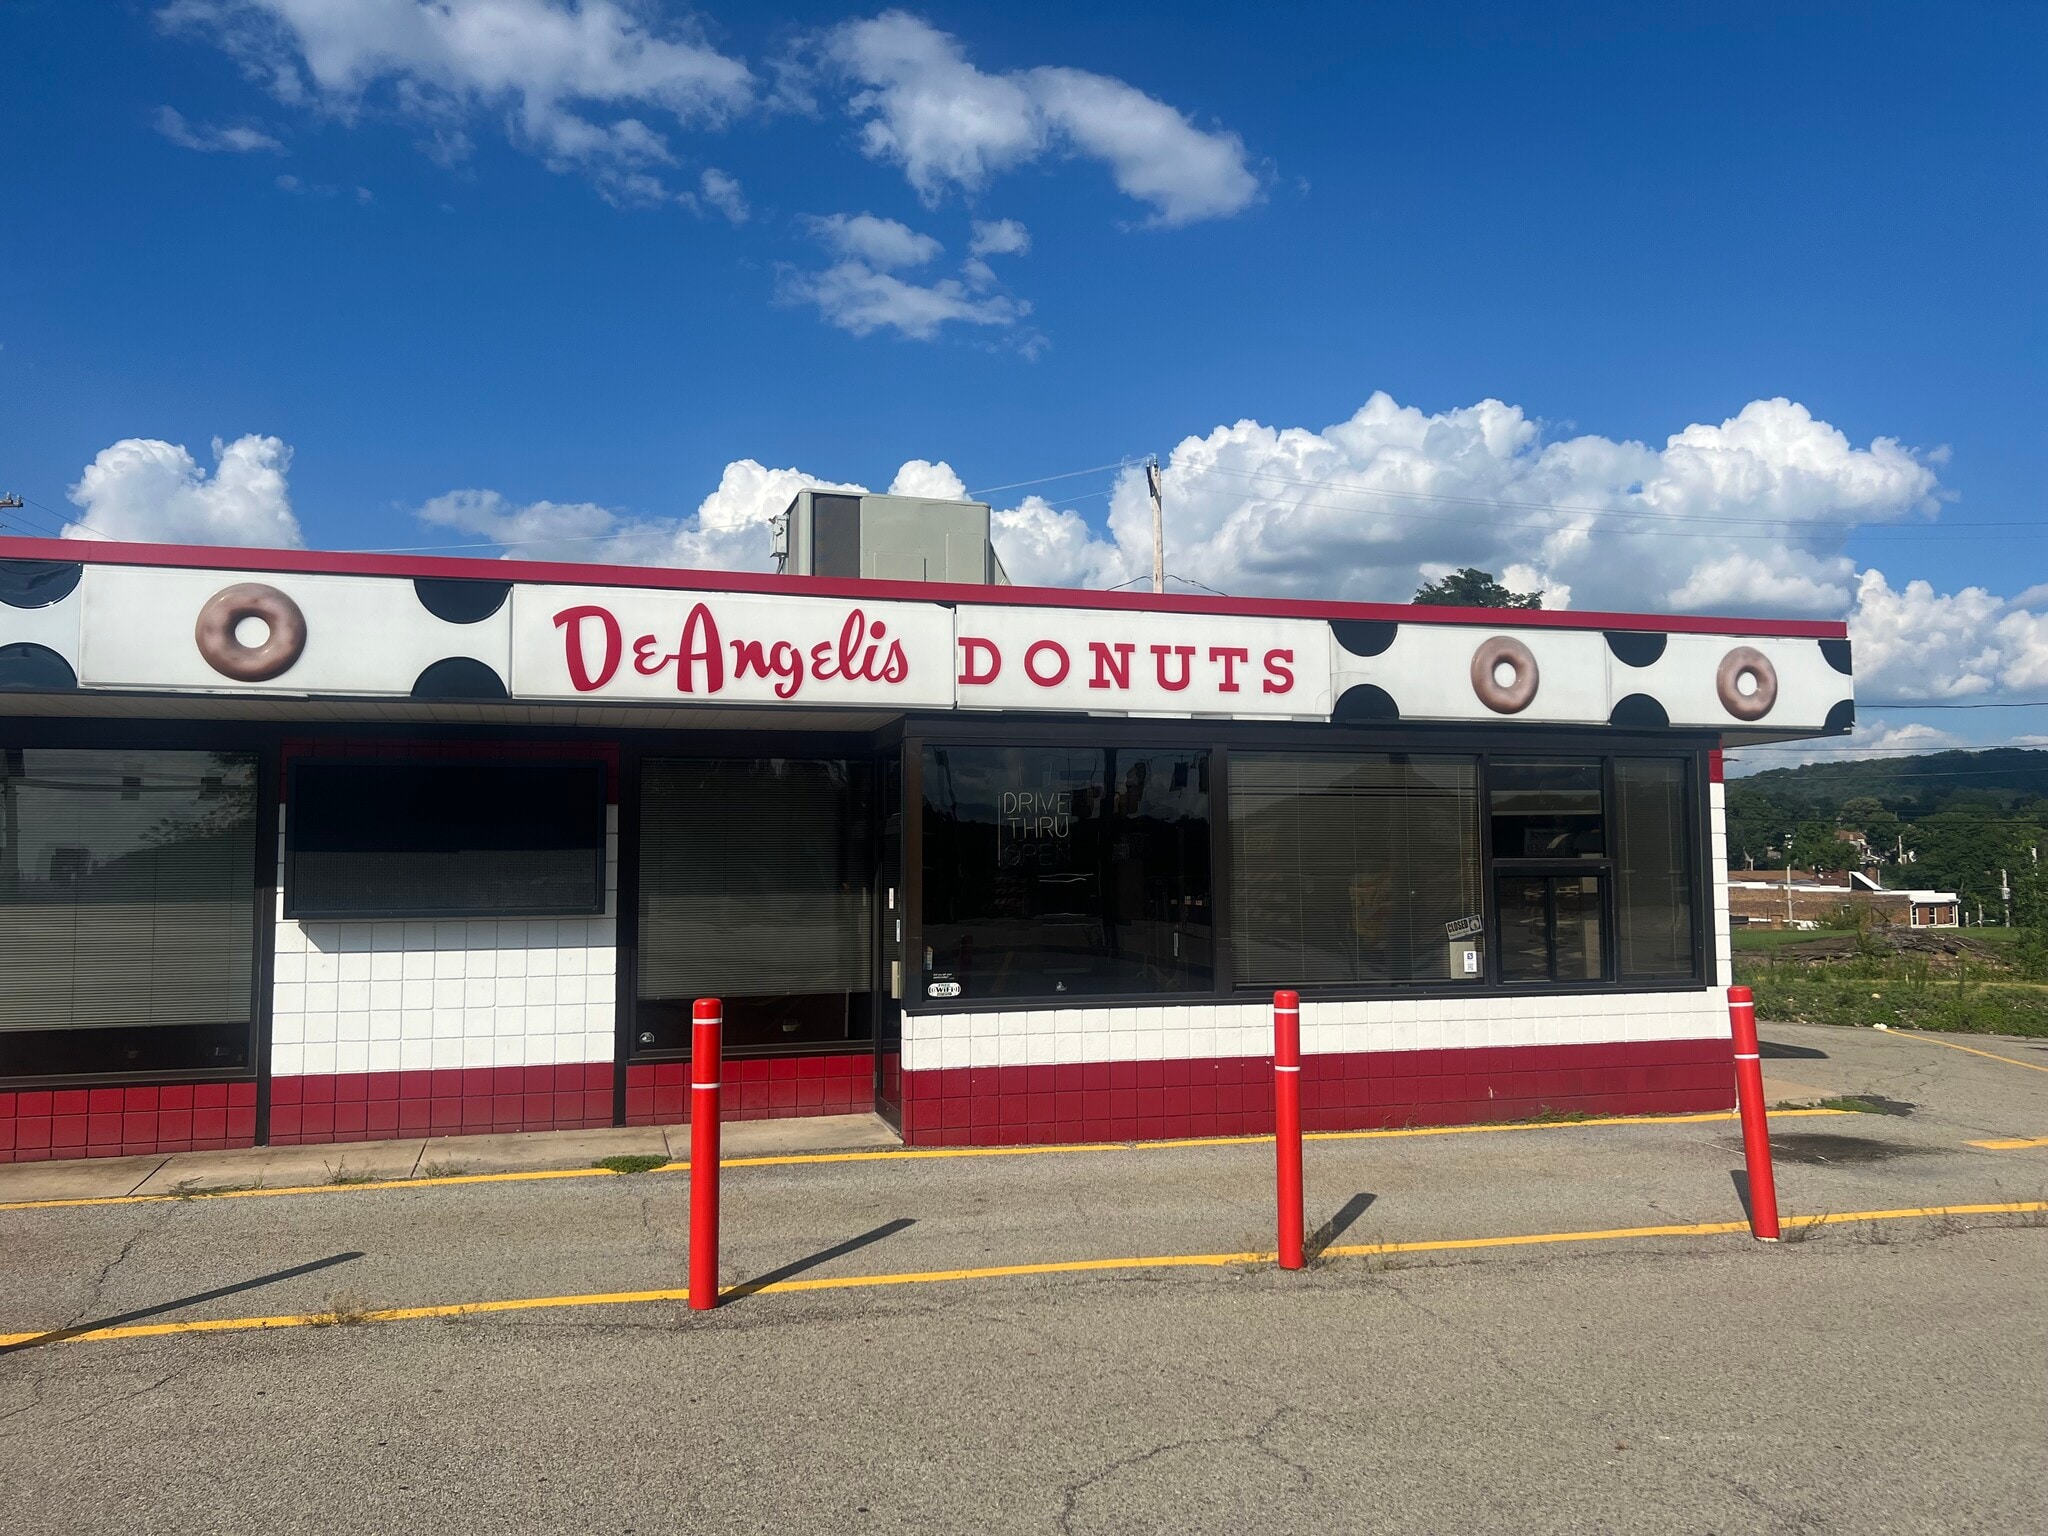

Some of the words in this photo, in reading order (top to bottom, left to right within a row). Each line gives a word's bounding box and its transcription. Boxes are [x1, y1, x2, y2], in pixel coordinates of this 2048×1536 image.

[552, 602, 910, 699] DeAngelis
[958, 637, 1295, 695] DONUTS
[1003, 791, 1071, 815] DRIVE
[1006, 815, 1069, 839] THRU
[1004, 843, 1071, 866] OPEN
[1446, 919, 1469, 933] CLOSED
